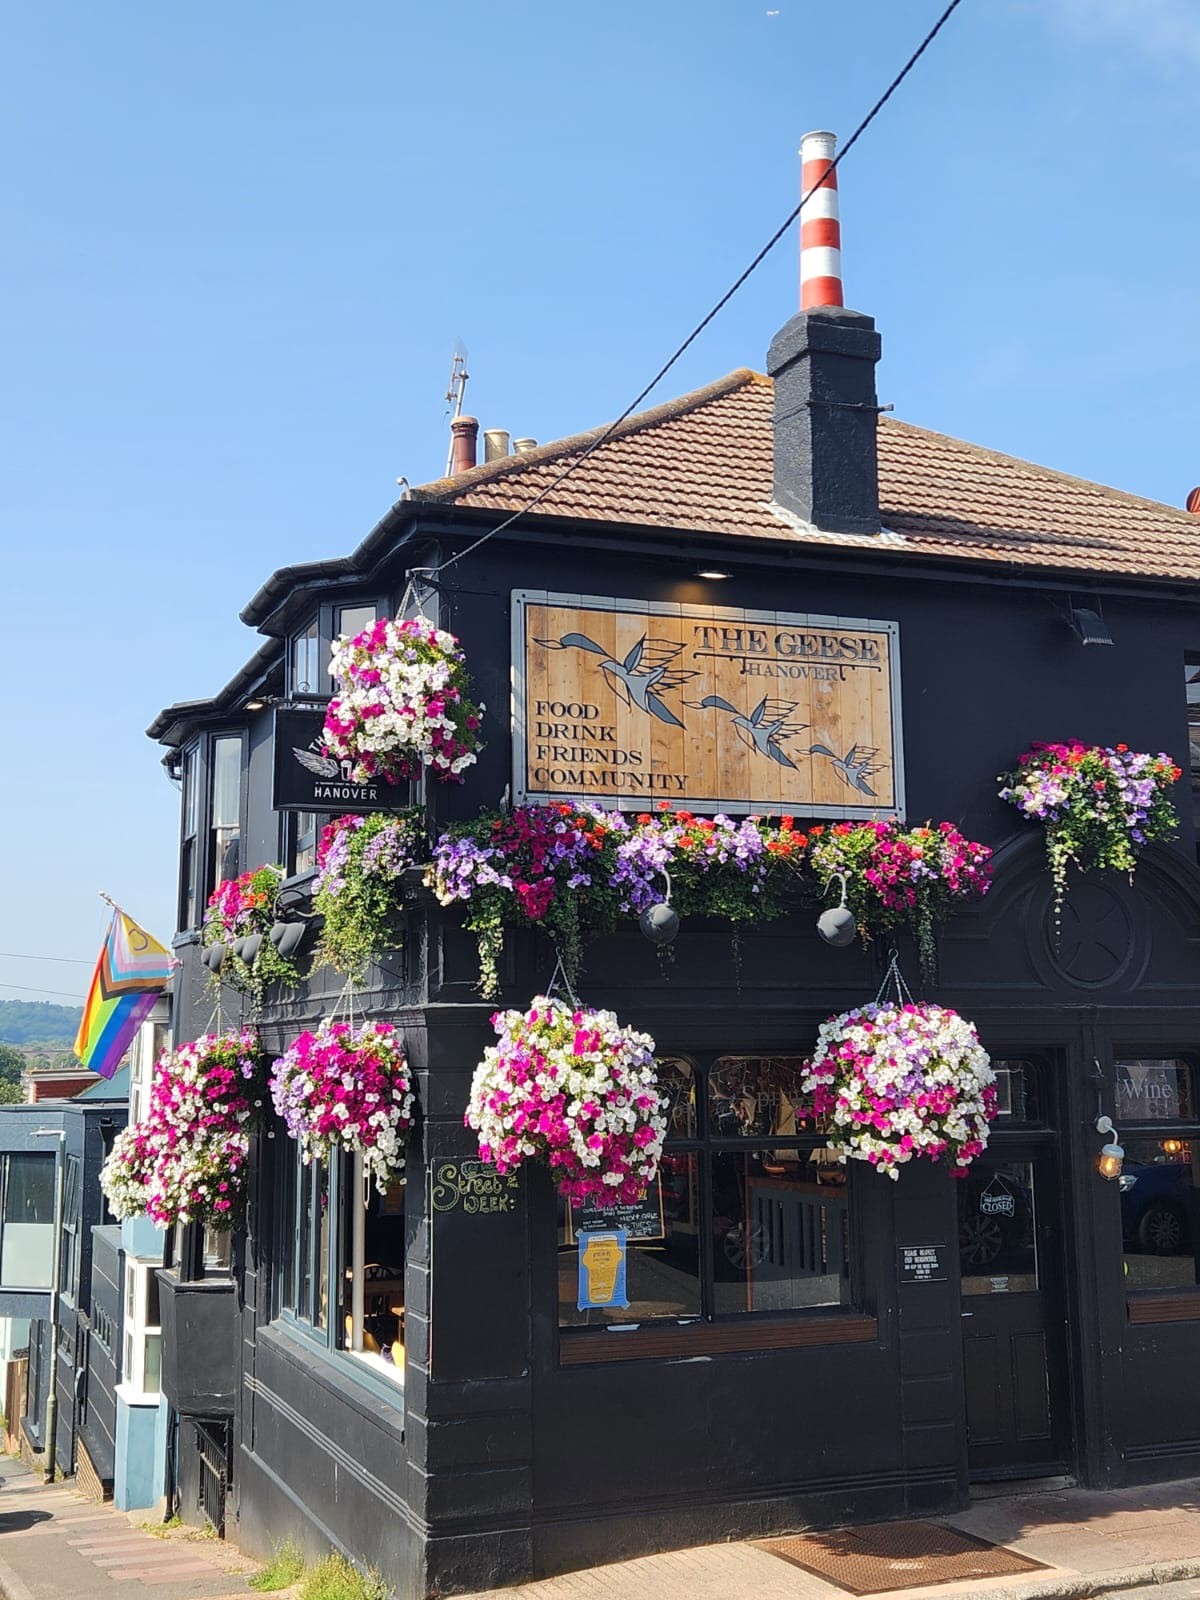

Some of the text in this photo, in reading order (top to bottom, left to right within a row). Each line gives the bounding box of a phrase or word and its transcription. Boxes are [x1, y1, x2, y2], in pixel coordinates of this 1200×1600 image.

[693, 625, 881, 662] THE GEESE
[747, 661, 839, 682] HANOVER
[534, 700, 599, 719] FOOD
[534, 721, 617, 742] DRINK
[308, 735, 327, 752] TH
[534, 744, 643, 766] FRIENDS
[534, 768, 689, 791] COMMUNITY
[314, 786, 377, 800] HANOVER
[1122, 1078, 1173, 1099] Wine
[982, 1201, 1013, 1212] CLOSED
